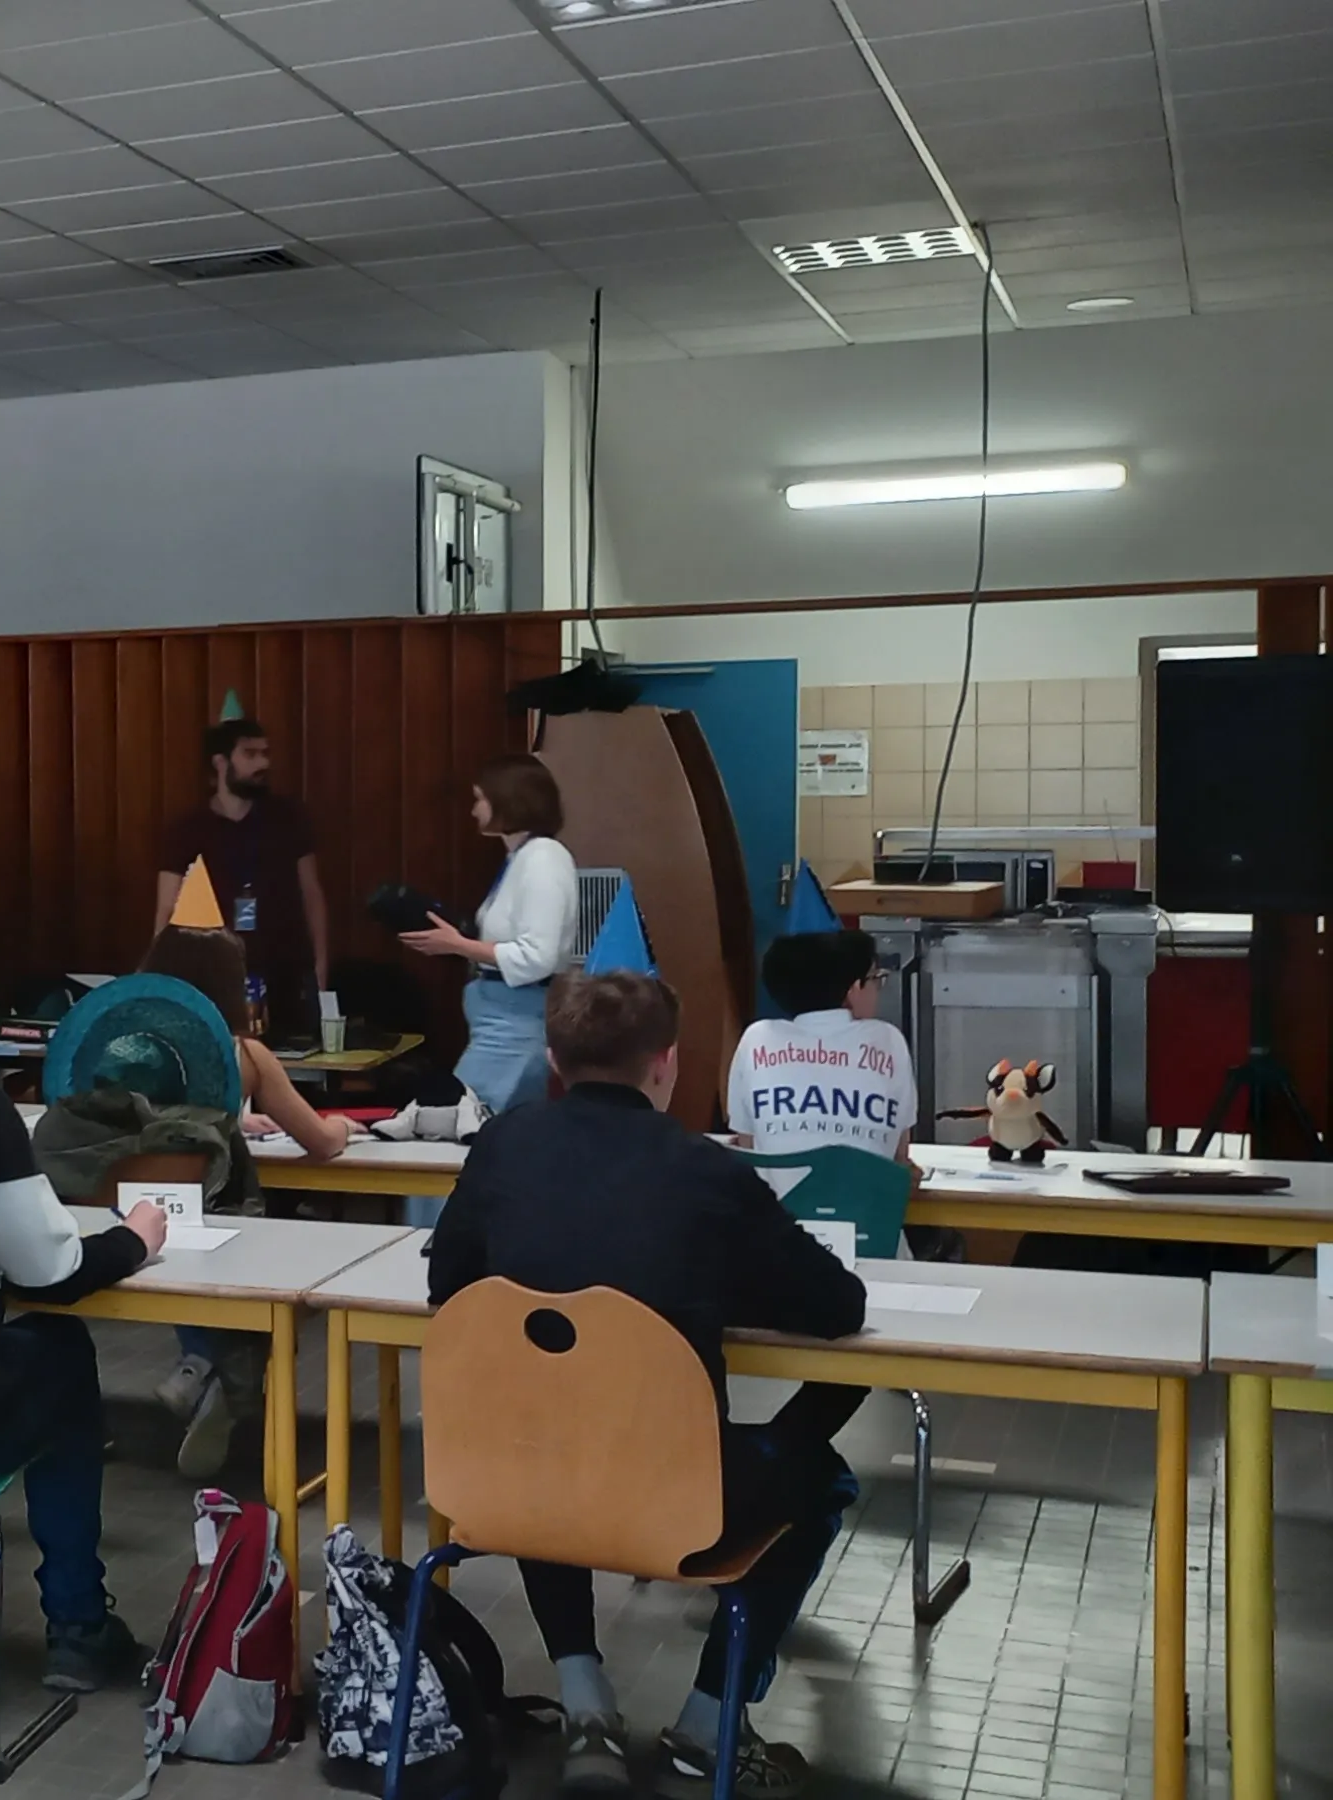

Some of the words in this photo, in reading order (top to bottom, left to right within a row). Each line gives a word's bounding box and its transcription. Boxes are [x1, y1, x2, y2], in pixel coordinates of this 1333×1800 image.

[753, 1039, 849, 1071] Montauban
[858, 1043, 895, 1078] 2024
[753, 1084, 900, 1129] FRANCE
[168, 1203, 184, 1214] 13
